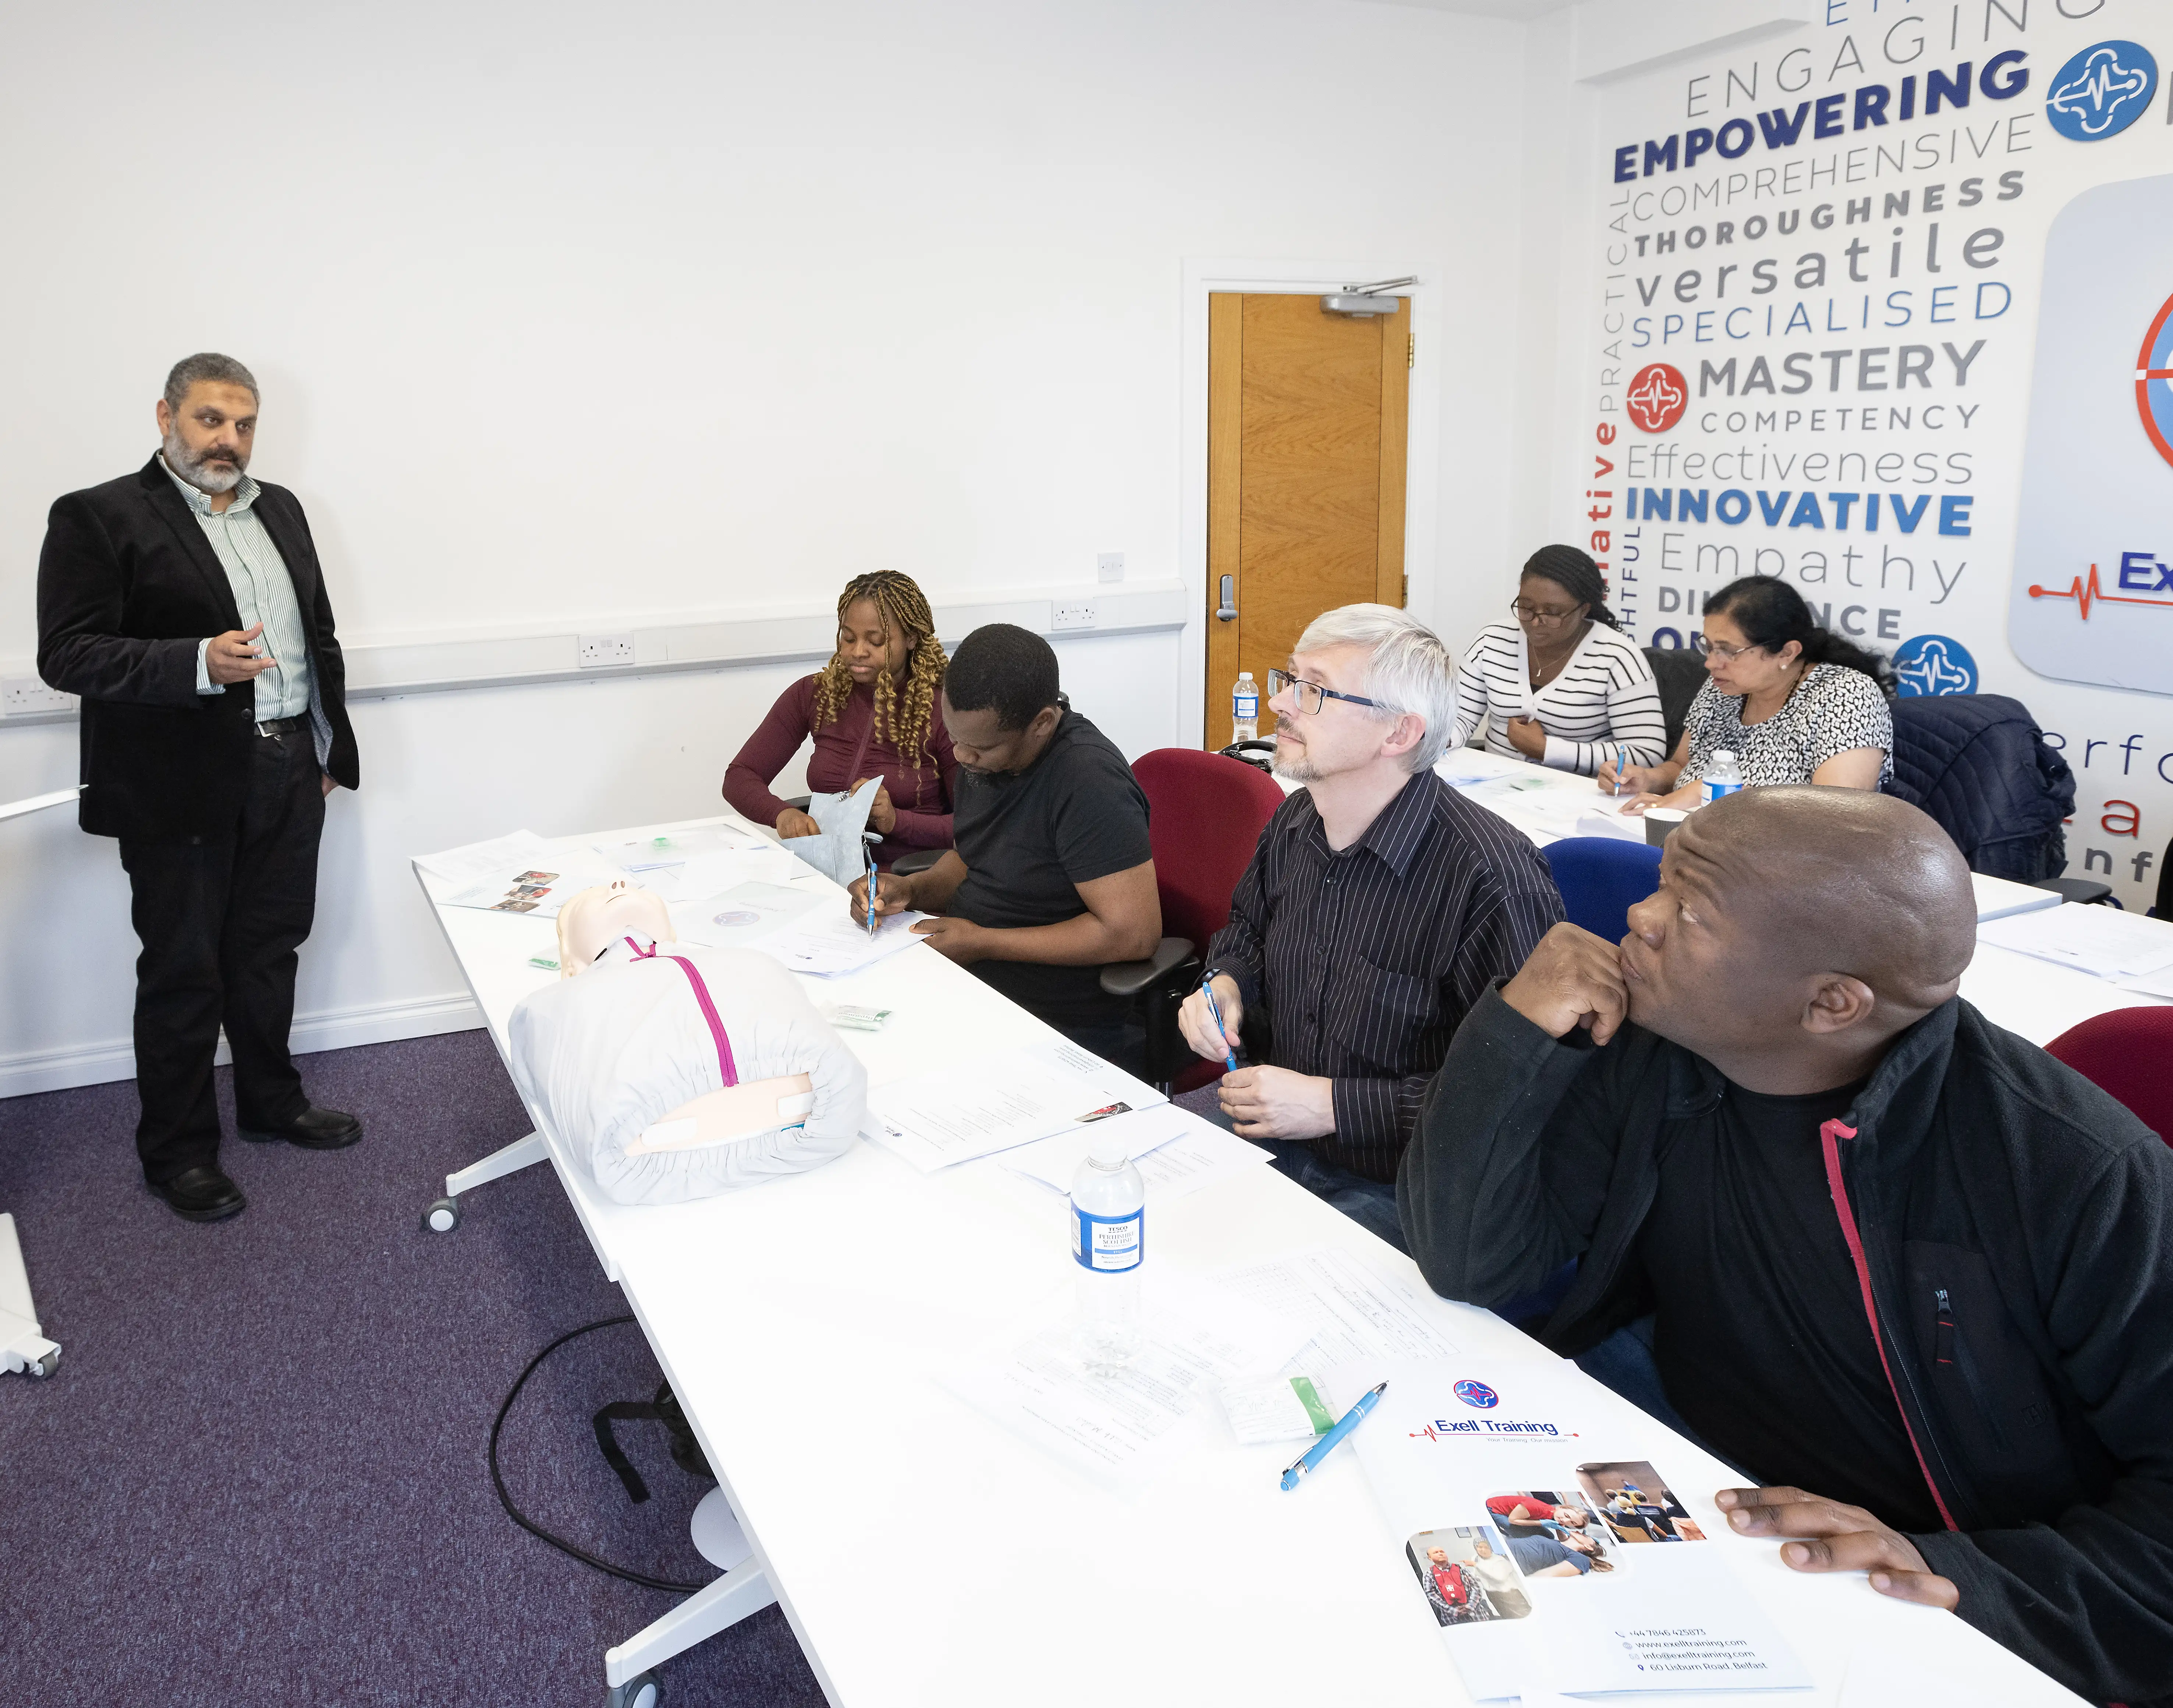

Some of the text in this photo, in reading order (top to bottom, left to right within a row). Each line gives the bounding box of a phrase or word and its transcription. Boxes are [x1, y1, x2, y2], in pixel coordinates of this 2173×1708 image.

[1687, 0, 2105, 118] ENGAGIN
[1614, 49, 2030, 184] EMPOWERING
[1633, 113, 2034, 221] COMPREHENSIVE
[1635, 170, 2024, 257] THOROUGHNESS
[1636, 222, 2004, 306] versatile
[1600, 189, 1630, 412] PRACTICAL
[1631, 281, 2011, 348] SPECIALISED
[1699, 339, 1987, 398] MASTERY
[1701, 404, 1980, 433] COMPETENCY
[1627, 443, 1973, 484] Effectiveness
[1626, 487, 1974, 536] INNOVATIVE
[1661, 532, 1967, 604] Empathy
[1435, 1420, 1559, 1435] Exell Training
[1635, 1640, 1747, 1648] www.exelltraining.com
[1642, 1651, 1756, 1660] info@exelltraining.com
[1665, 1663, 1703, 1671] Lisburn
[1732, 1662, 1768, 1670] Belfast
